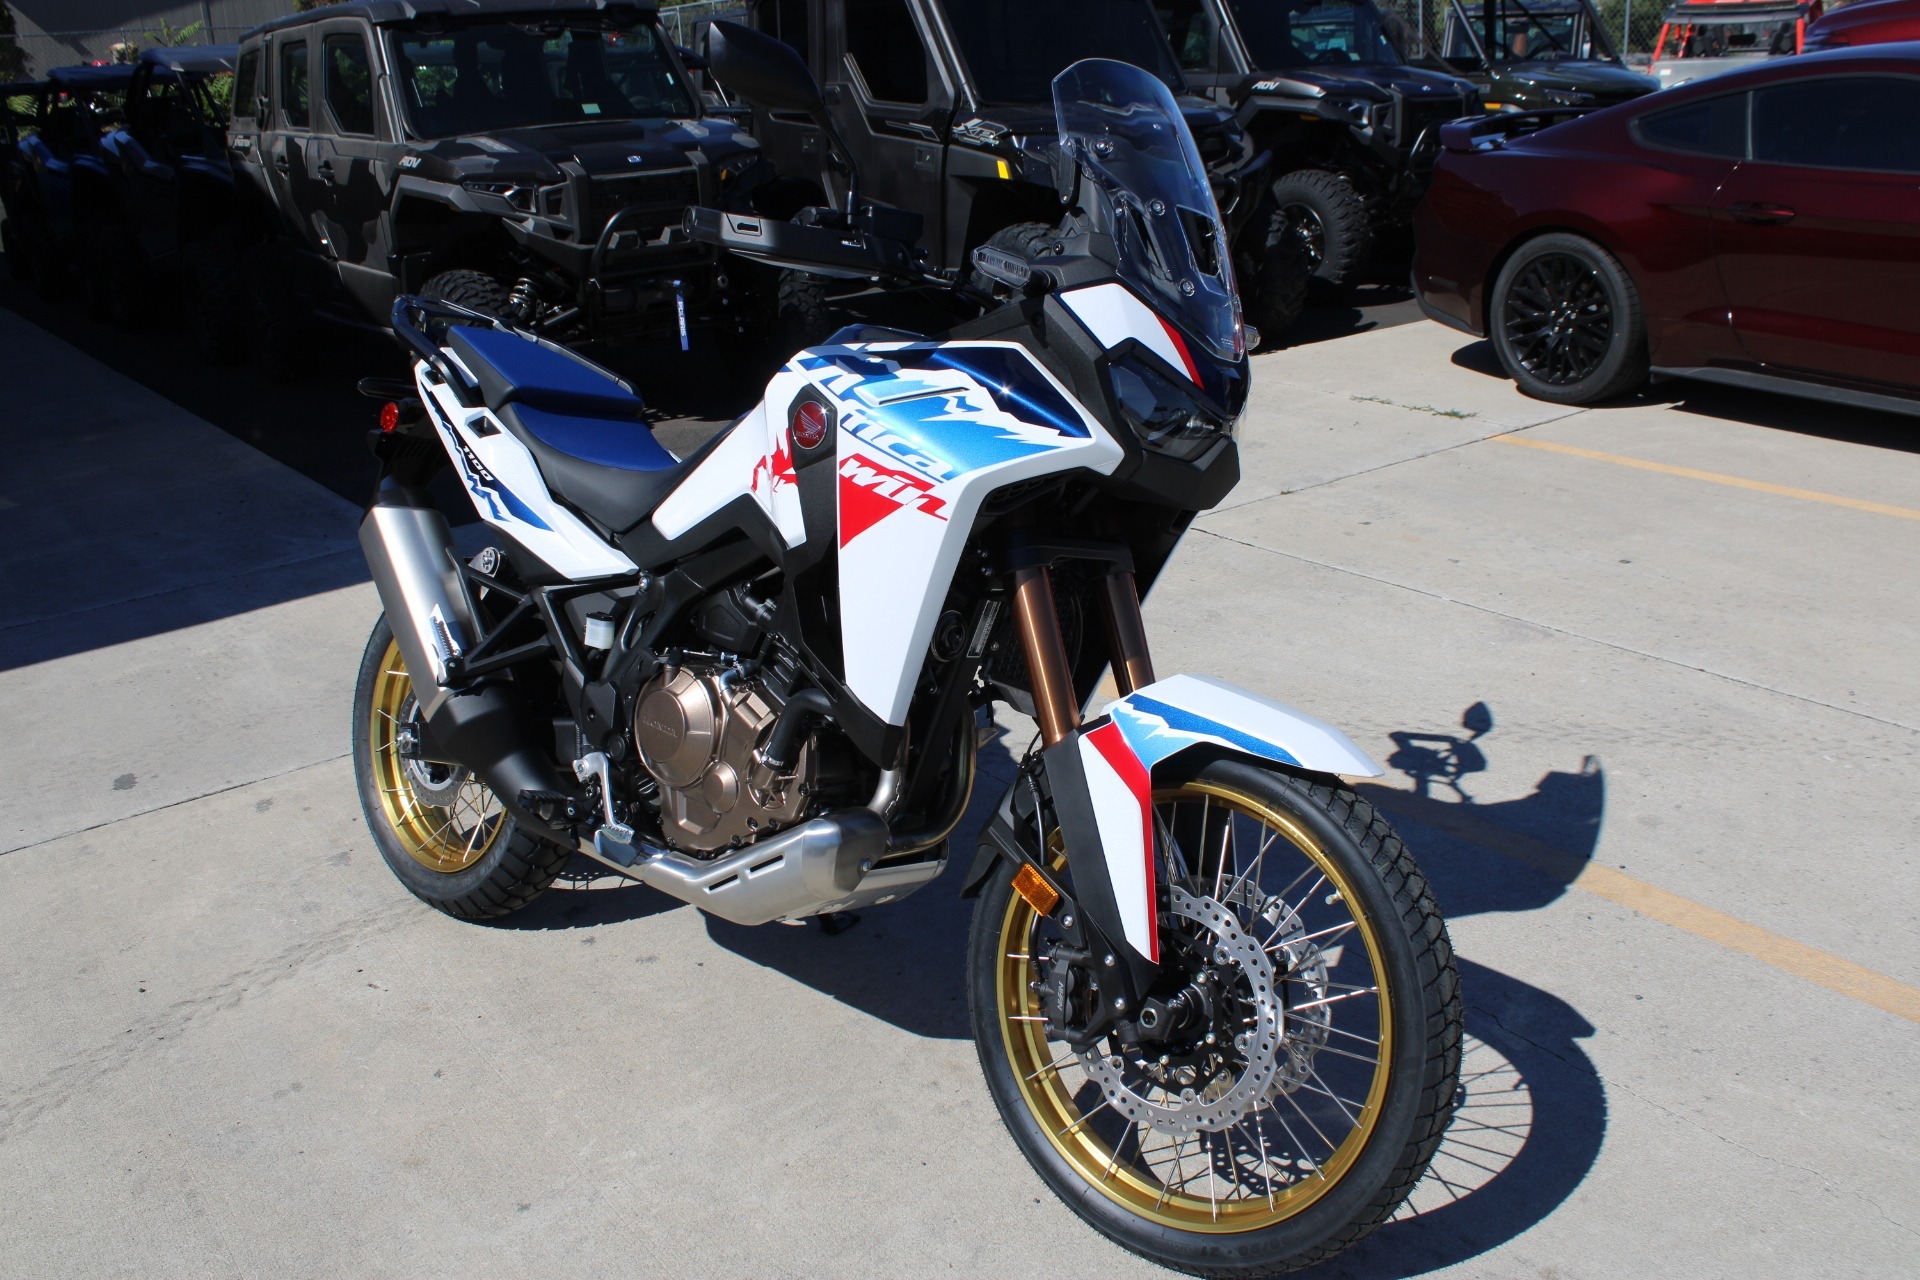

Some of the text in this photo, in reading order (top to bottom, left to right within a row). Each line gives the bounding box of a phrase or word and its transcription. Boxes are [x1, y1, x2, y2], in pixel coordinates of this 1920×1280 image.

[1251, 80, 1280, 91] ADV
[398, 155, 422, 169] ADV
[677, 301, 687, 337] POLARIS
[795, 431, 820, 441] HONDA
[463, 445, 494, 481] 1100
[643, 715, 678, 738] HONDA
